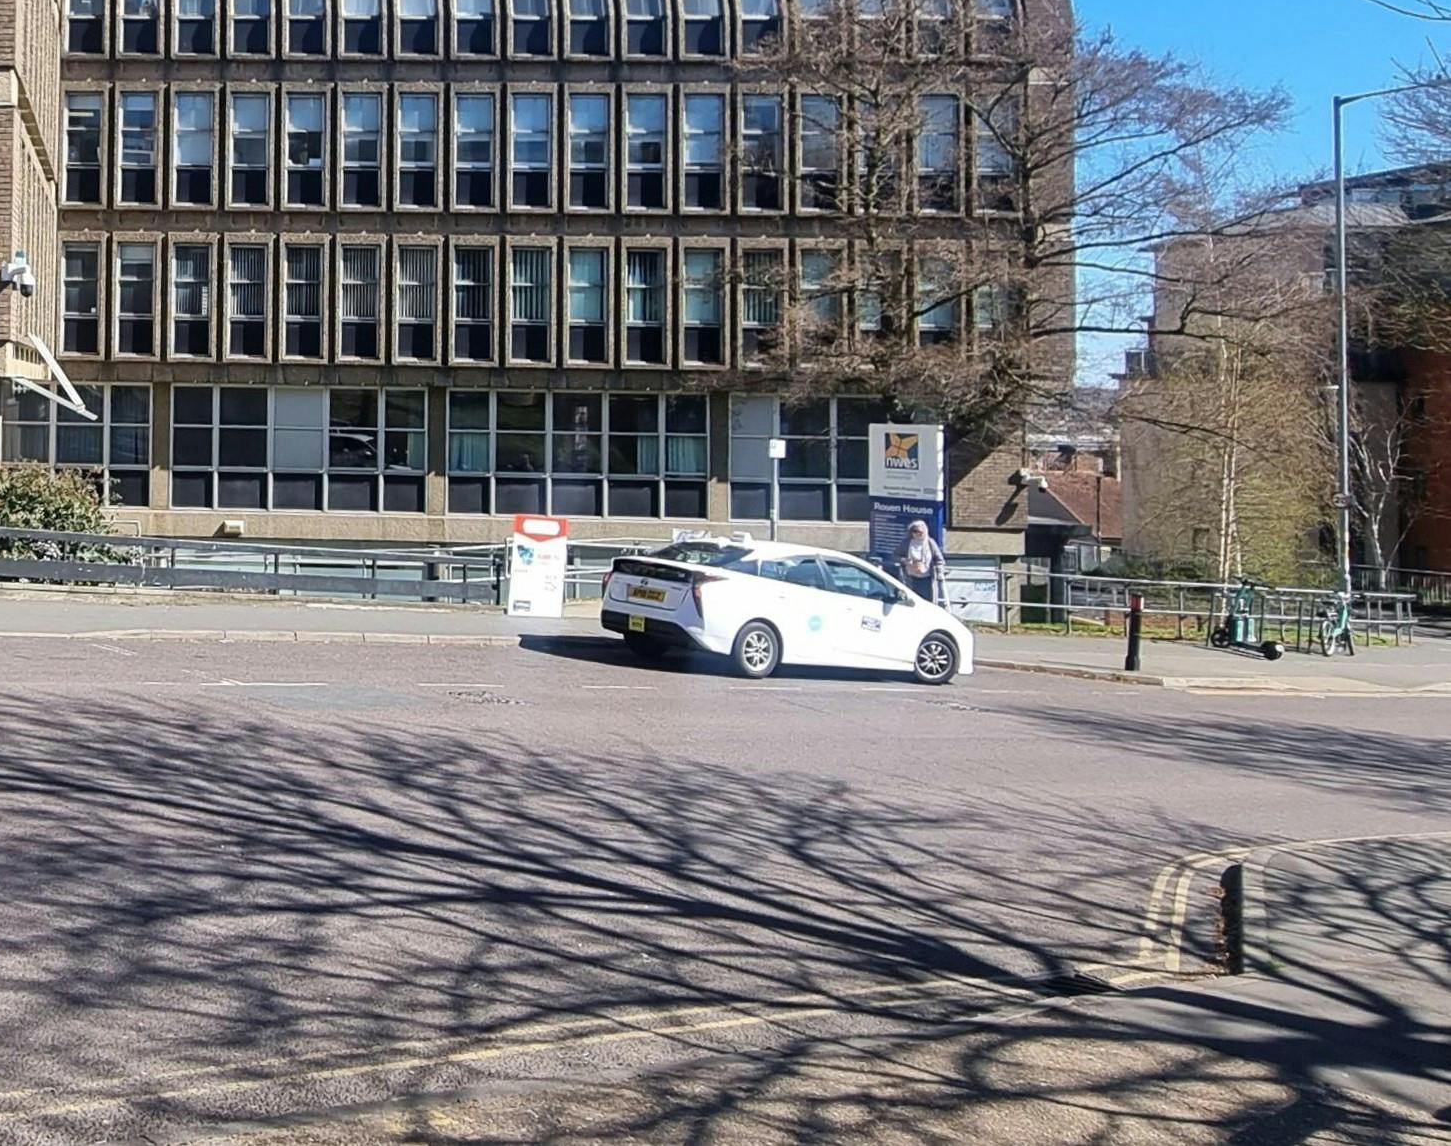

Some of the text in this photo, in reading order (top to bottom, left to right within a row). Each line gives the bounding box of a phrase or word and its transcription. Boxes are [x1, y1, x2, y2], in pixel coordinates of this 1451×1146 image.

[886, 458, 918, 468] nwes
[874, 502, 934, 514] Rouen House
